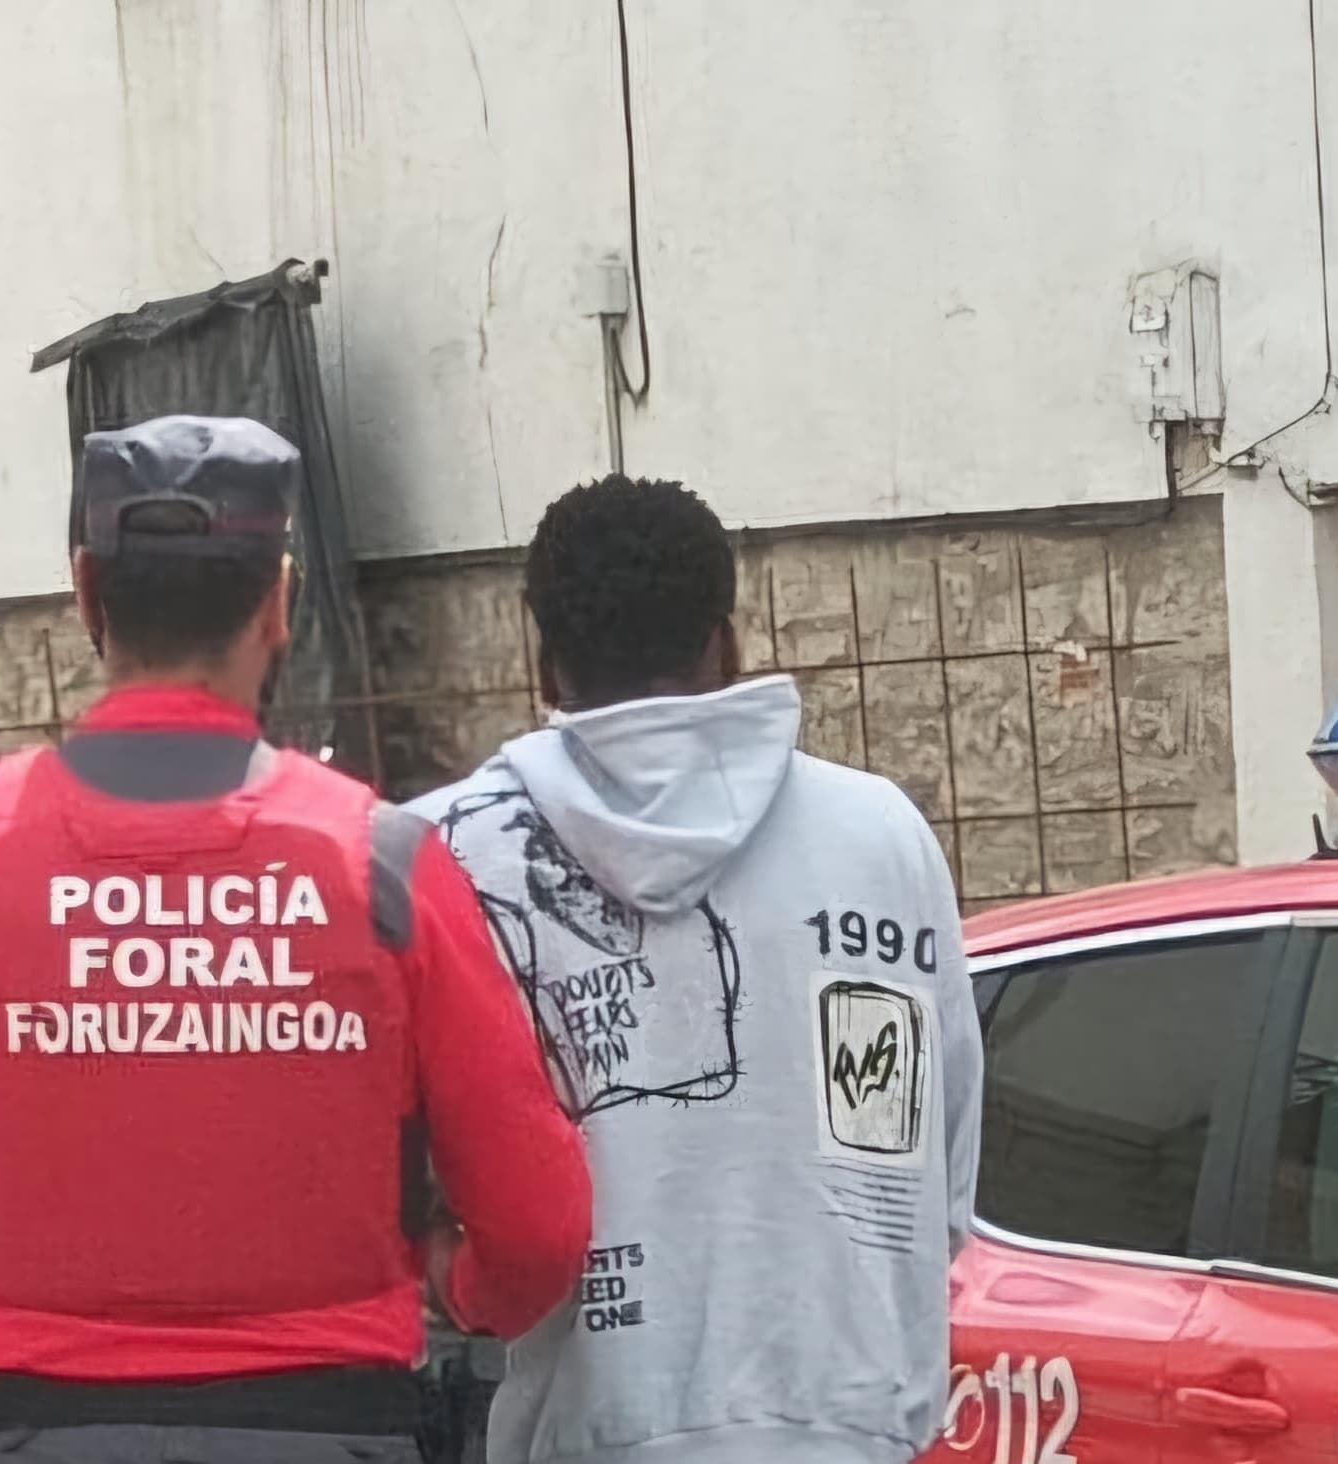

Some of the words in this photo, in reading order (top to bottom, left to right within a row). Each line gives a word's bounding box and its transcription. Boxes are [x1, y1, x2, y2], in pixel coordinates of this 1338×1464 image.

[49, 861, 329, 926] POLICÍA
[69, 936, 315, 988] FORAL
[803, 909, 937, 974] 1990
[5, 1000, 367, 1054] FORUZAINGOA
